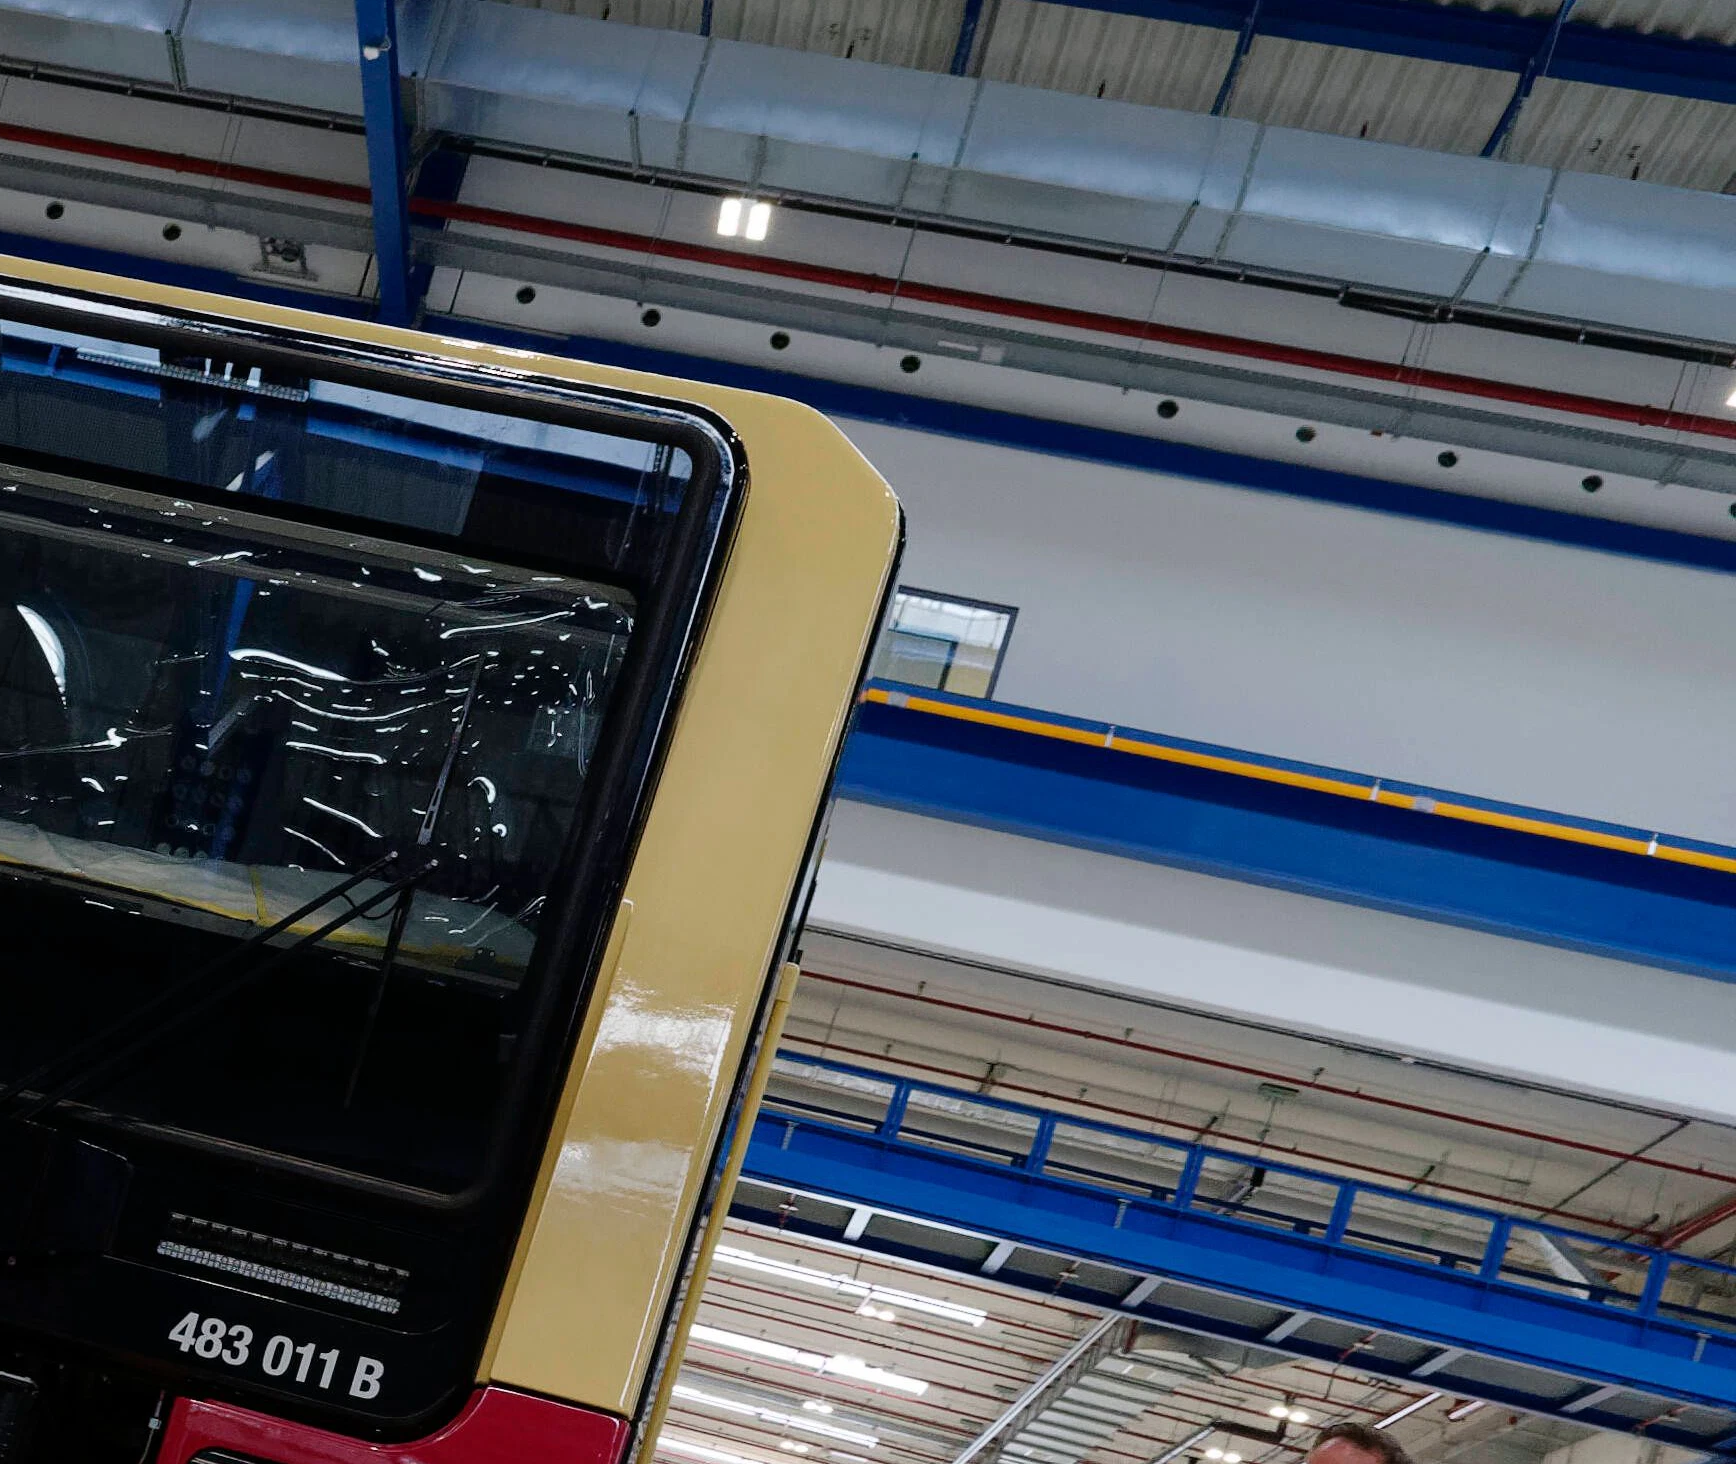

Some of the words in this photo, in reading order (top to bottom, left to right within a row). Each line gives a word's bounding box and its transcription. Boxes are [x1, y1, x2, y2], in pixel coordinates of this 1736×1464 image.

[168, 1311, 254, 1366] 483
[262, 1335, 340, 1390] 011
[348, 1356, 385, 1400] B
